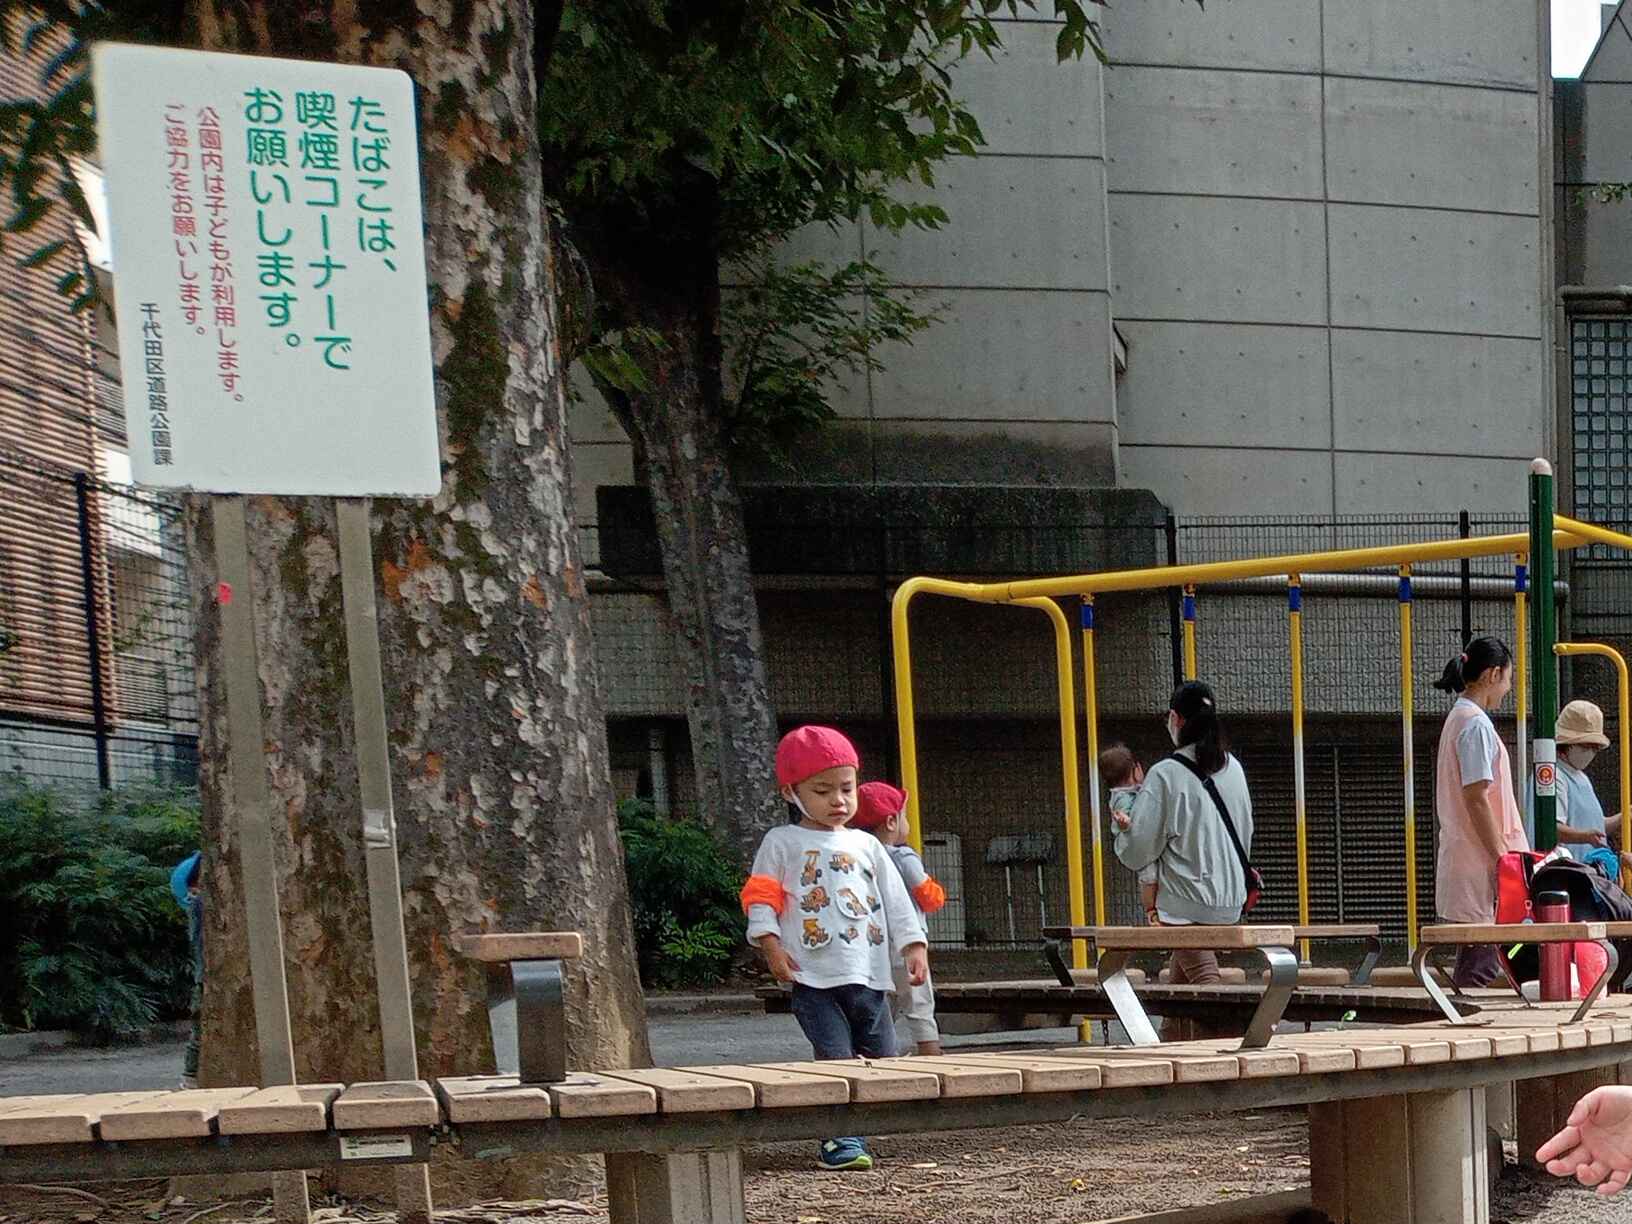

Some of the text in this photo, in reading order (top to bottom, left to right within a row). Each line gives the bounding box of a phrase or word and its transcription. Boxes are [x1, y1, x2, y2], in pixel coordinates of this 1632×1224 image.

[164, 103, 206, 336] ご協力をお願いします。
[197, 105, 243, 402] 公園内は子どもが利用します。
[244, 86, 301, 348] お願いします。
[295, 91, 353, 371] 喫煙コーナーで
[349, 95, 398, 273] たばこは、
[139, 302, 174, 466] 千代田区道路公園課
